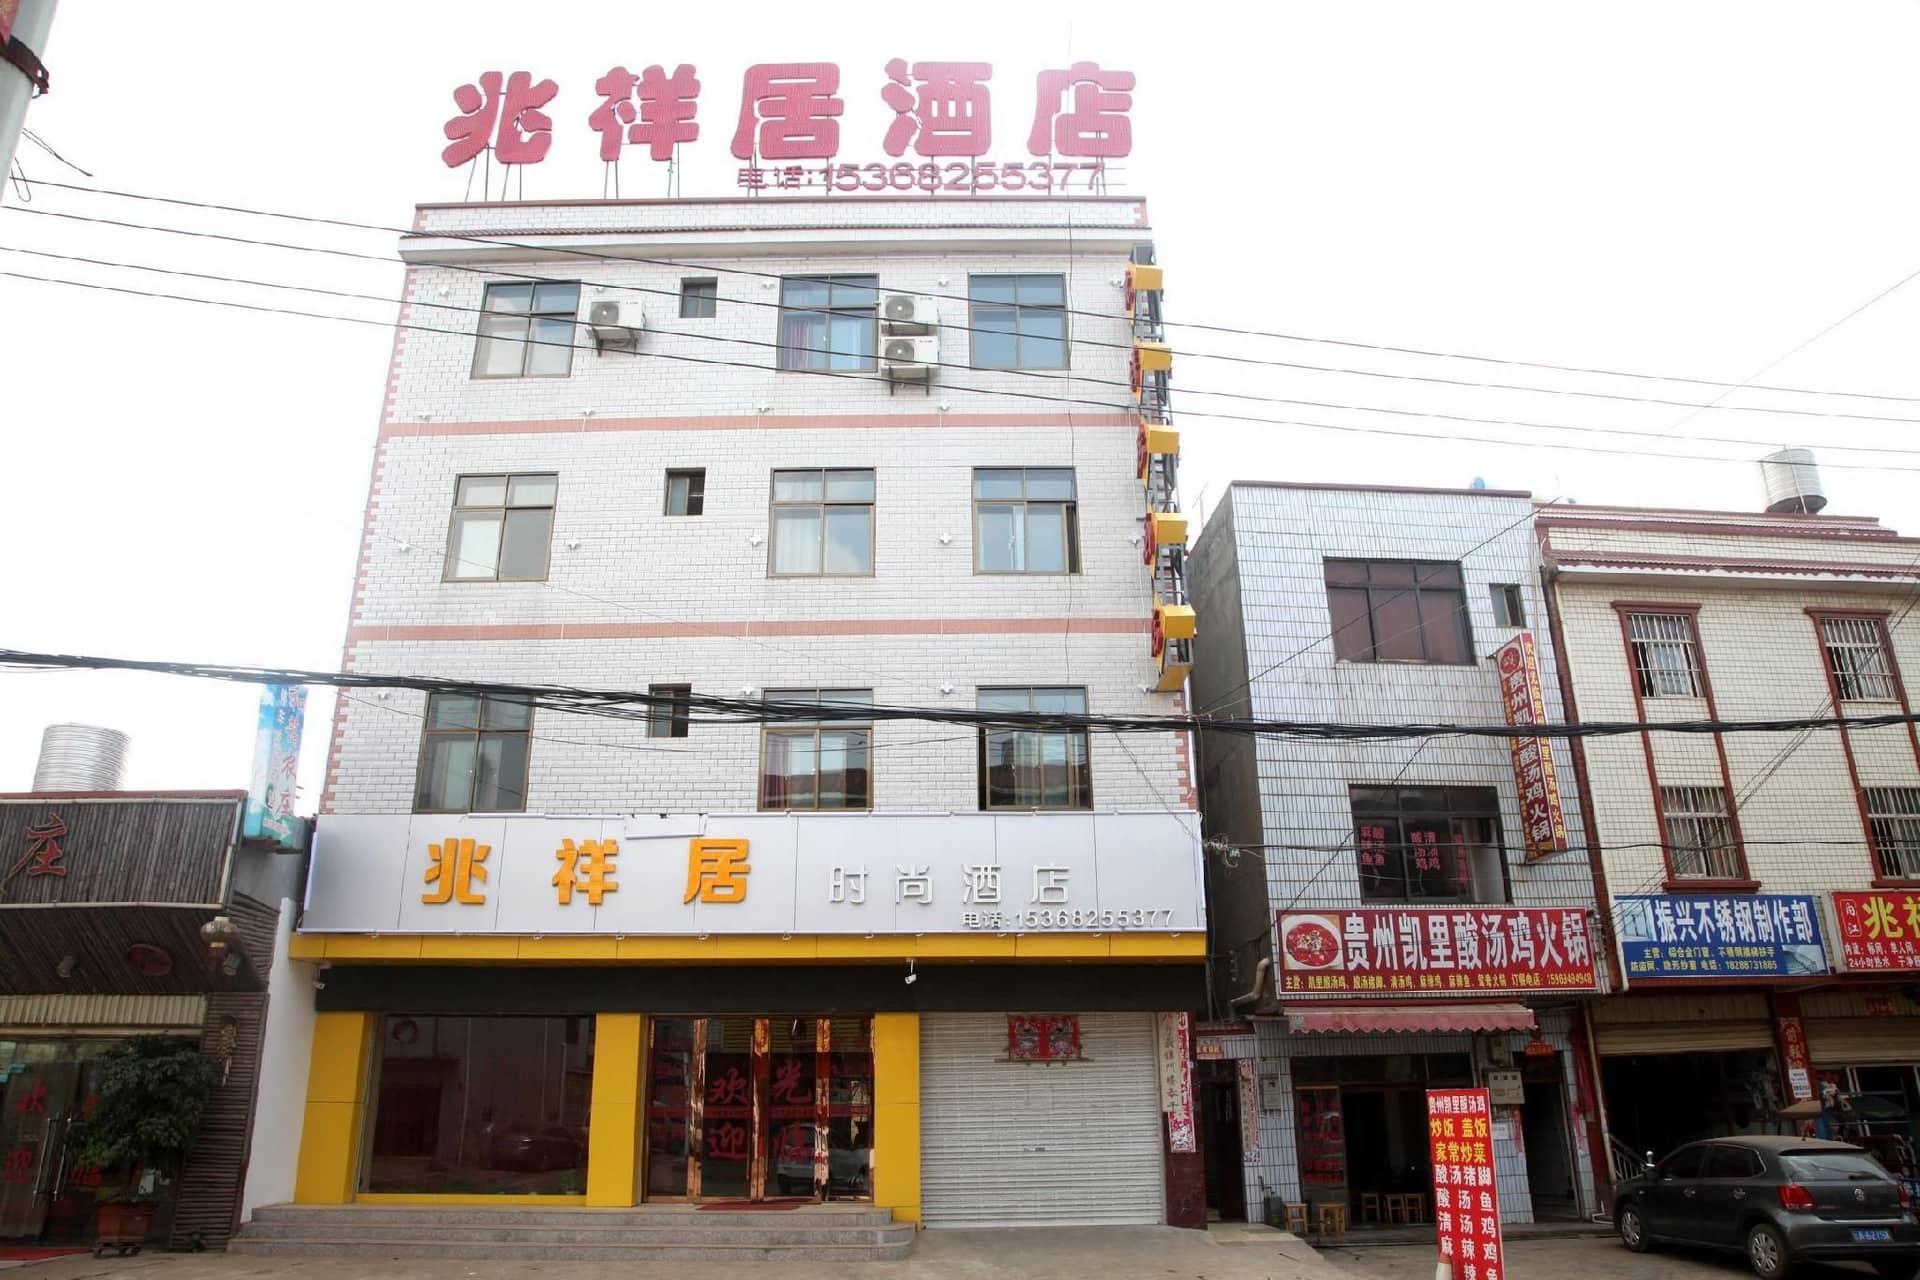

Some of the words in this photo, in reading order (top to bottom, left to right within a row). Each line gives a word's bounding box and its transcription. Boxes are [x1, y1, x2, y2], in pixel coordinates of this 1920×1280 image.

[441, 59, 1136, 168] 兆祥居酒店
[8, 812, 67, 877] 庄
[421, 838, 752, 905] 兆祥居
[828, 862, 1073, 905] 时尚酒店
[1343, 910, 1590, 971] 贵州凯里酸汤鸡火锅
[1655, 899, 1814, 944] 振兴不锈钢制作部
[707, 1068, 749, 1160] 欢迎
[1428, 1095, 1486, 1114] 贵州凯里酸汤鸡
[1431, 1118, 1455, 1137] 炒饭
[1462, 1118, 1487, 1138] 盖饭
[1435, 1142, 1487, 1163] 家常炒菜
[1435, 1164, 1492, 1186] 酸汤猪脚
[1436, 1188, 1494, 1212] 酸汤鱼
[1439, 1211, 1496, 1238] 清汤鸡
